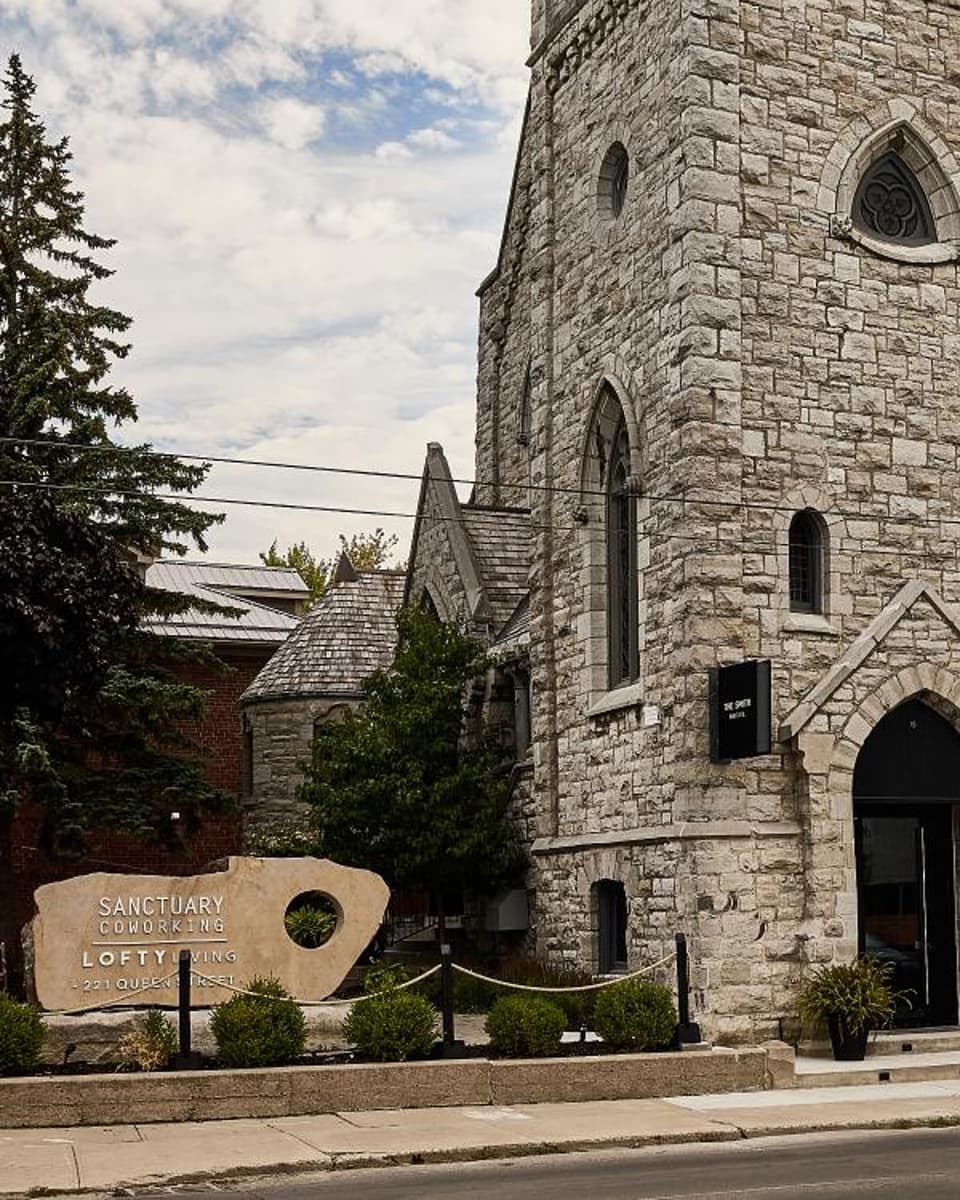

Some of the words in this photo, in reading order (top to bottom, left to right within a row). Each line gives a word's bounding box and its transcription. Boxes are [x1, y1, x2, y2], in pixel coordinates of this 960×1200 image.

[98, 896, 224, 916] SANCTUARY
[99, 919, 224, 935] COWORKING
[82, 950, 166, 968] LOFTY
[172, 950, 237, 964] LVING
[116, 976, 170, 990] QUEEN
